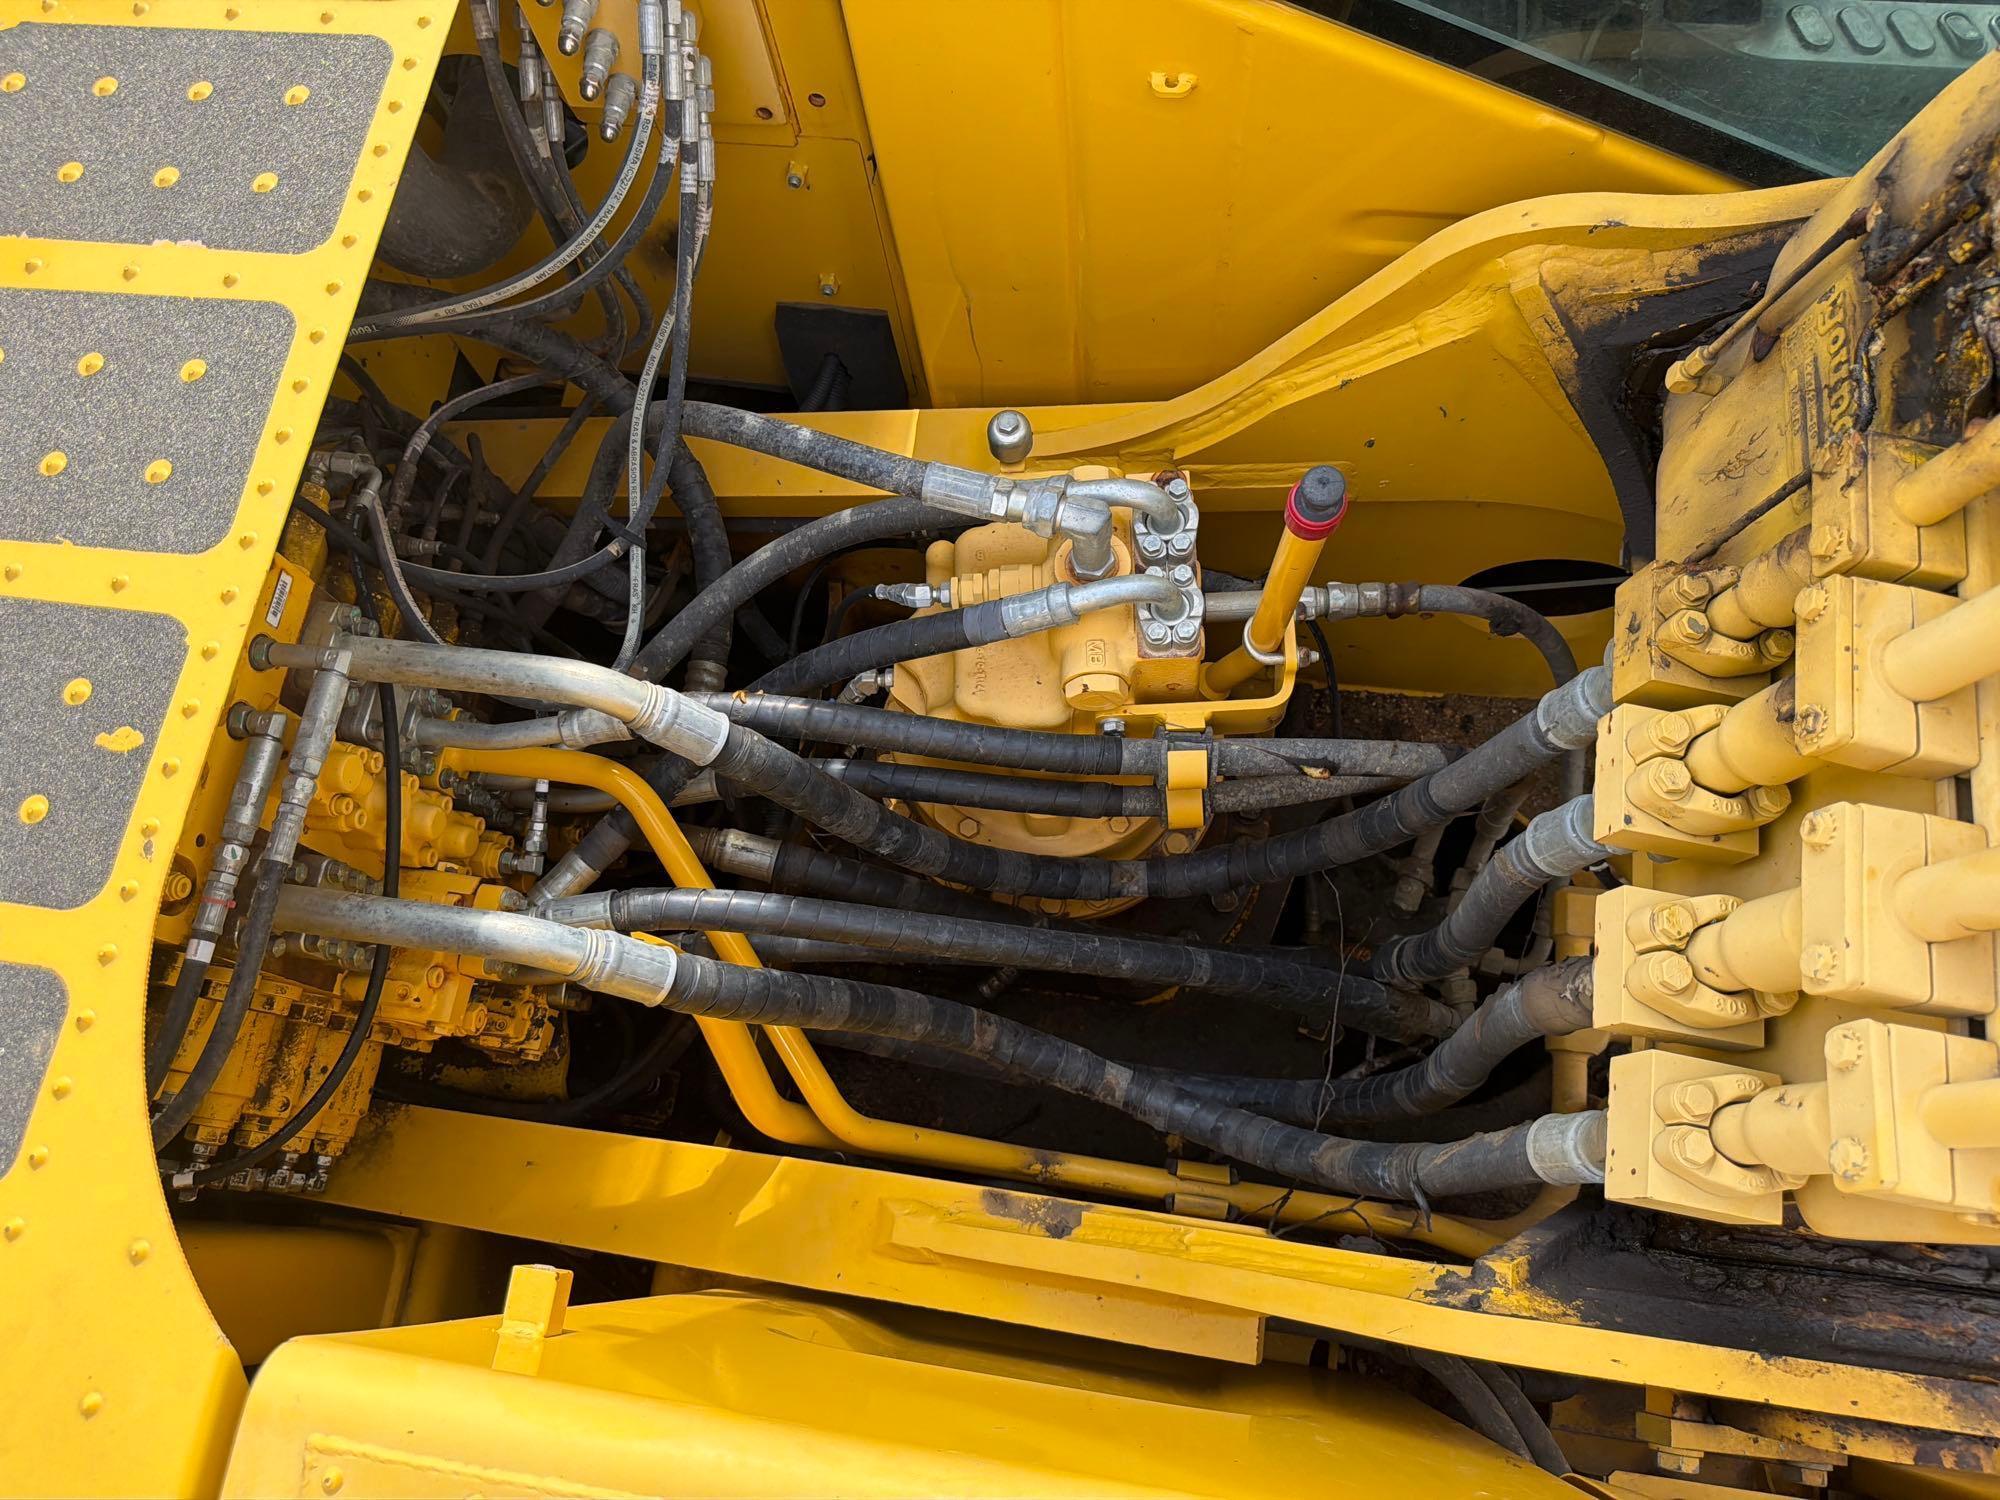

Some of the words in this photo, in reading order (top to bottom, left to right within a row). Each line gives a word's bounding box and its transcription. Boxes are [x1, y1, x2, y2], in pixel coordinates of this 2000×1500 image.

[641, 118, 651, 134] PSI
[631, 140, 645, 166] MSHA
[600, 203, 616, 225] FRAS
[567, 229, 597, 258] ABRASION
[533, 257, 568, 283] RESISTANT
[654, 337, 664, 351] PSI
[644, 355, 657, 377] MSHA
[631, 416, 641, 438] FRAS
[630, 446, 638, 484] ABRASION
[1712, 798, 1744, 816] 603
[1719, 898, 1738, 913] 60
[1715, 996, 1748, 1015] 603
